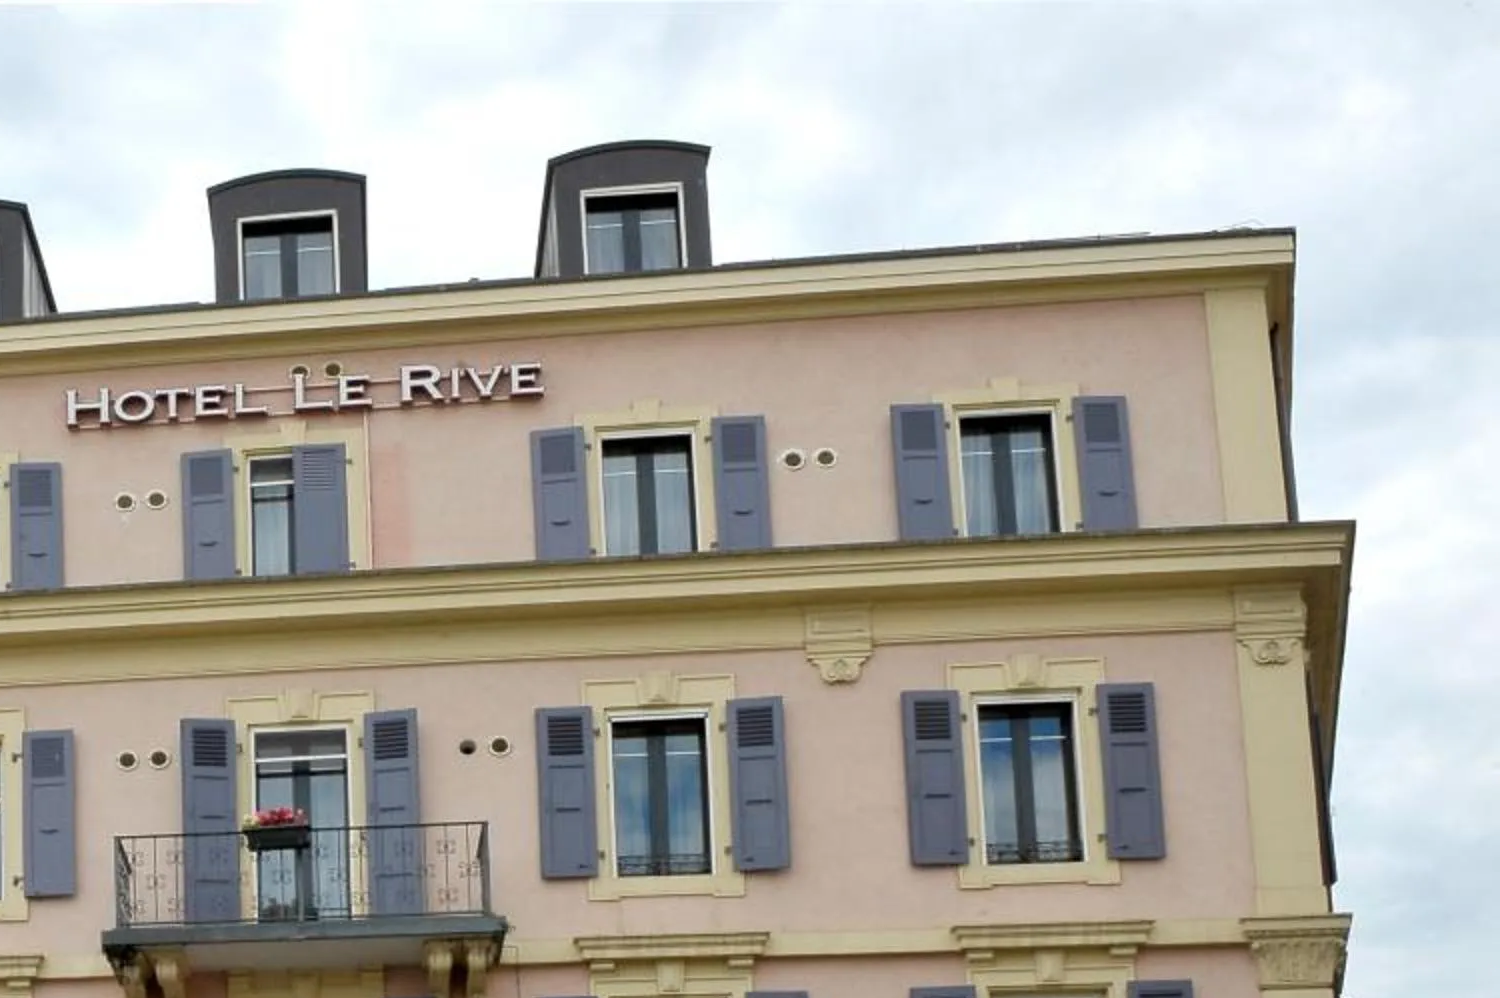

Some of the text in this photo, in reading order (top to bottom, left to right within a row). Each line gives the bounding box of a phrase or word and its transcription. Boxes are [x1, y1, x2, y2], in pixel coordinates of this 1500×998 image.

[64, 362, 545, 431] HOTEL LE RIVE
